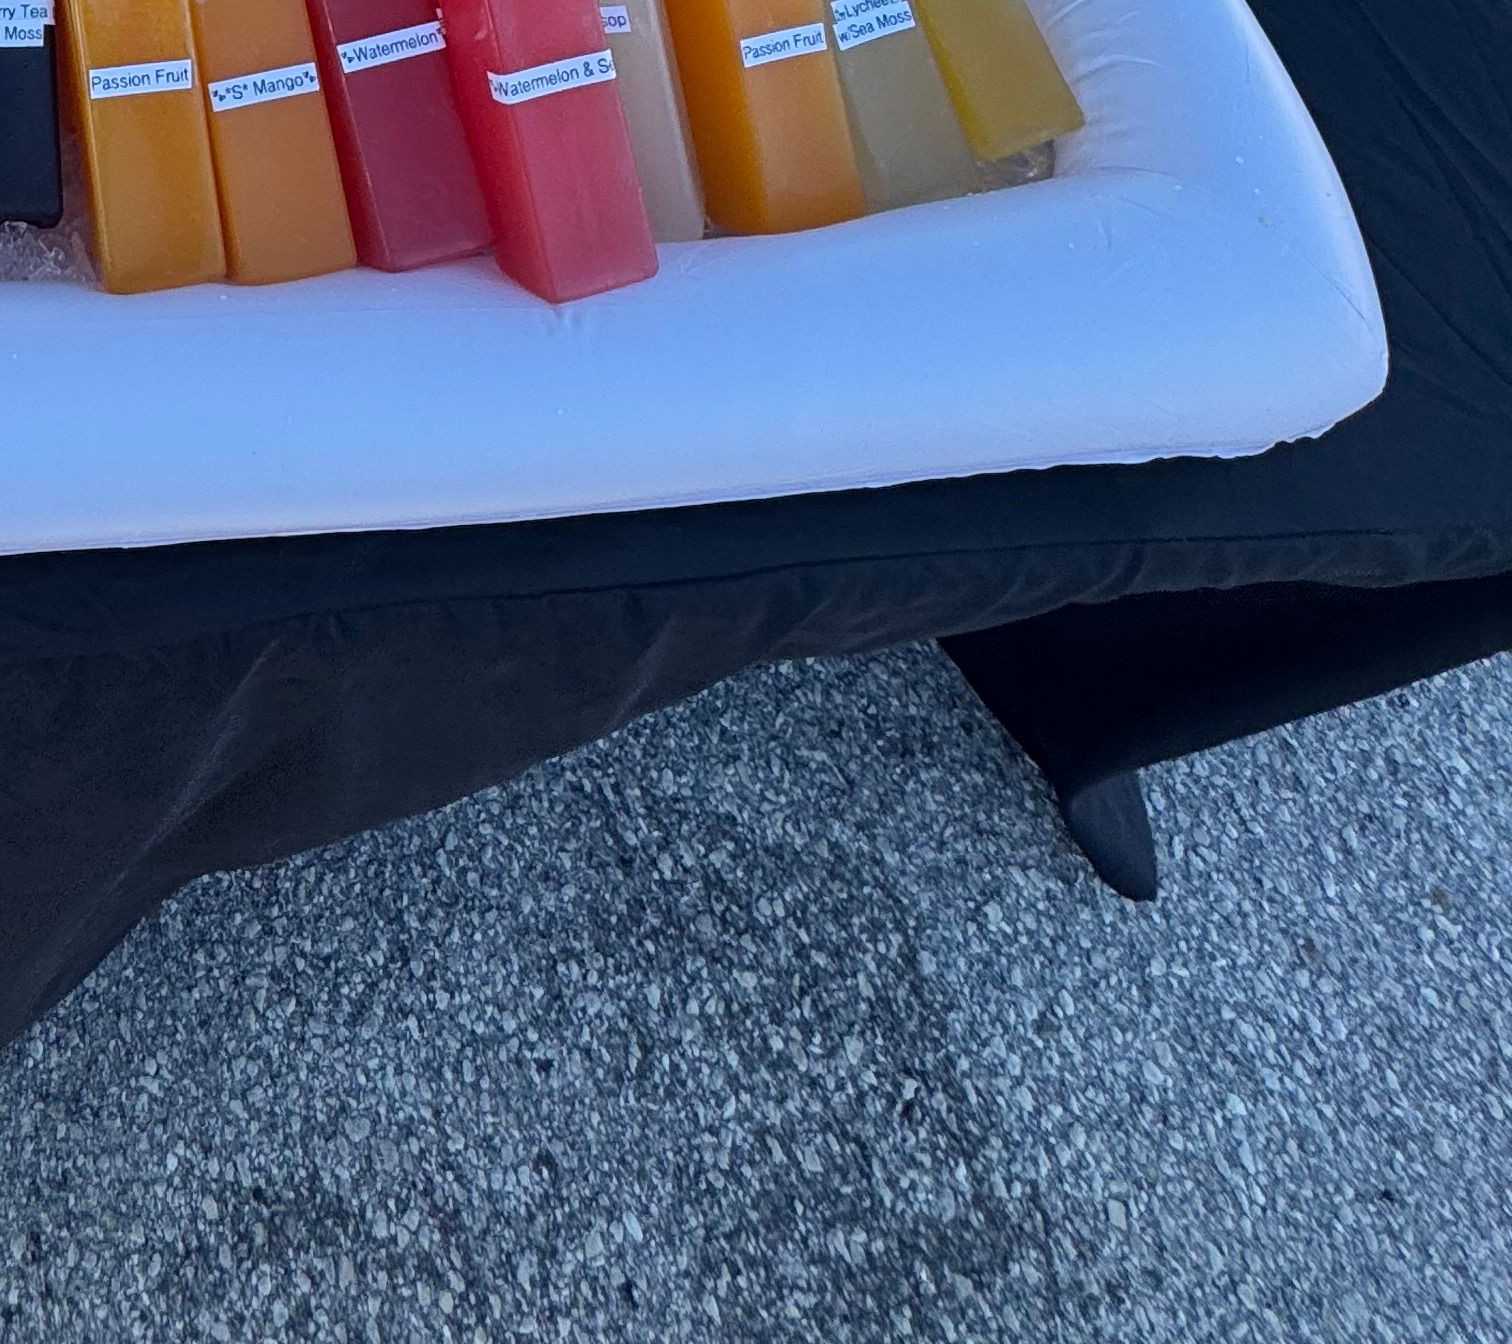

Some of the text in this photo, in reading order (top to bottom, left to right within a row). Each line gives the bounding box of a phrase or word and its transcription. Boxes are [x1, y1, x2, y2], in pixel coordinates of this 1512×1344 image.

[20, 3, 48, 18] Tea
[4, 26, 43, 40] Moss
[838, 9, 912, 44] w/Sea Moss
[353, 29, 438, 63] Watermelon
[743, 29, 823, 59] Passion Fruit
[91, 67, 190, 91] Passion Fruit
[252, 75, 304, 97] Mango
[497, 64, 580, 98] Watermelon
[583, 61, 595, 78] &
